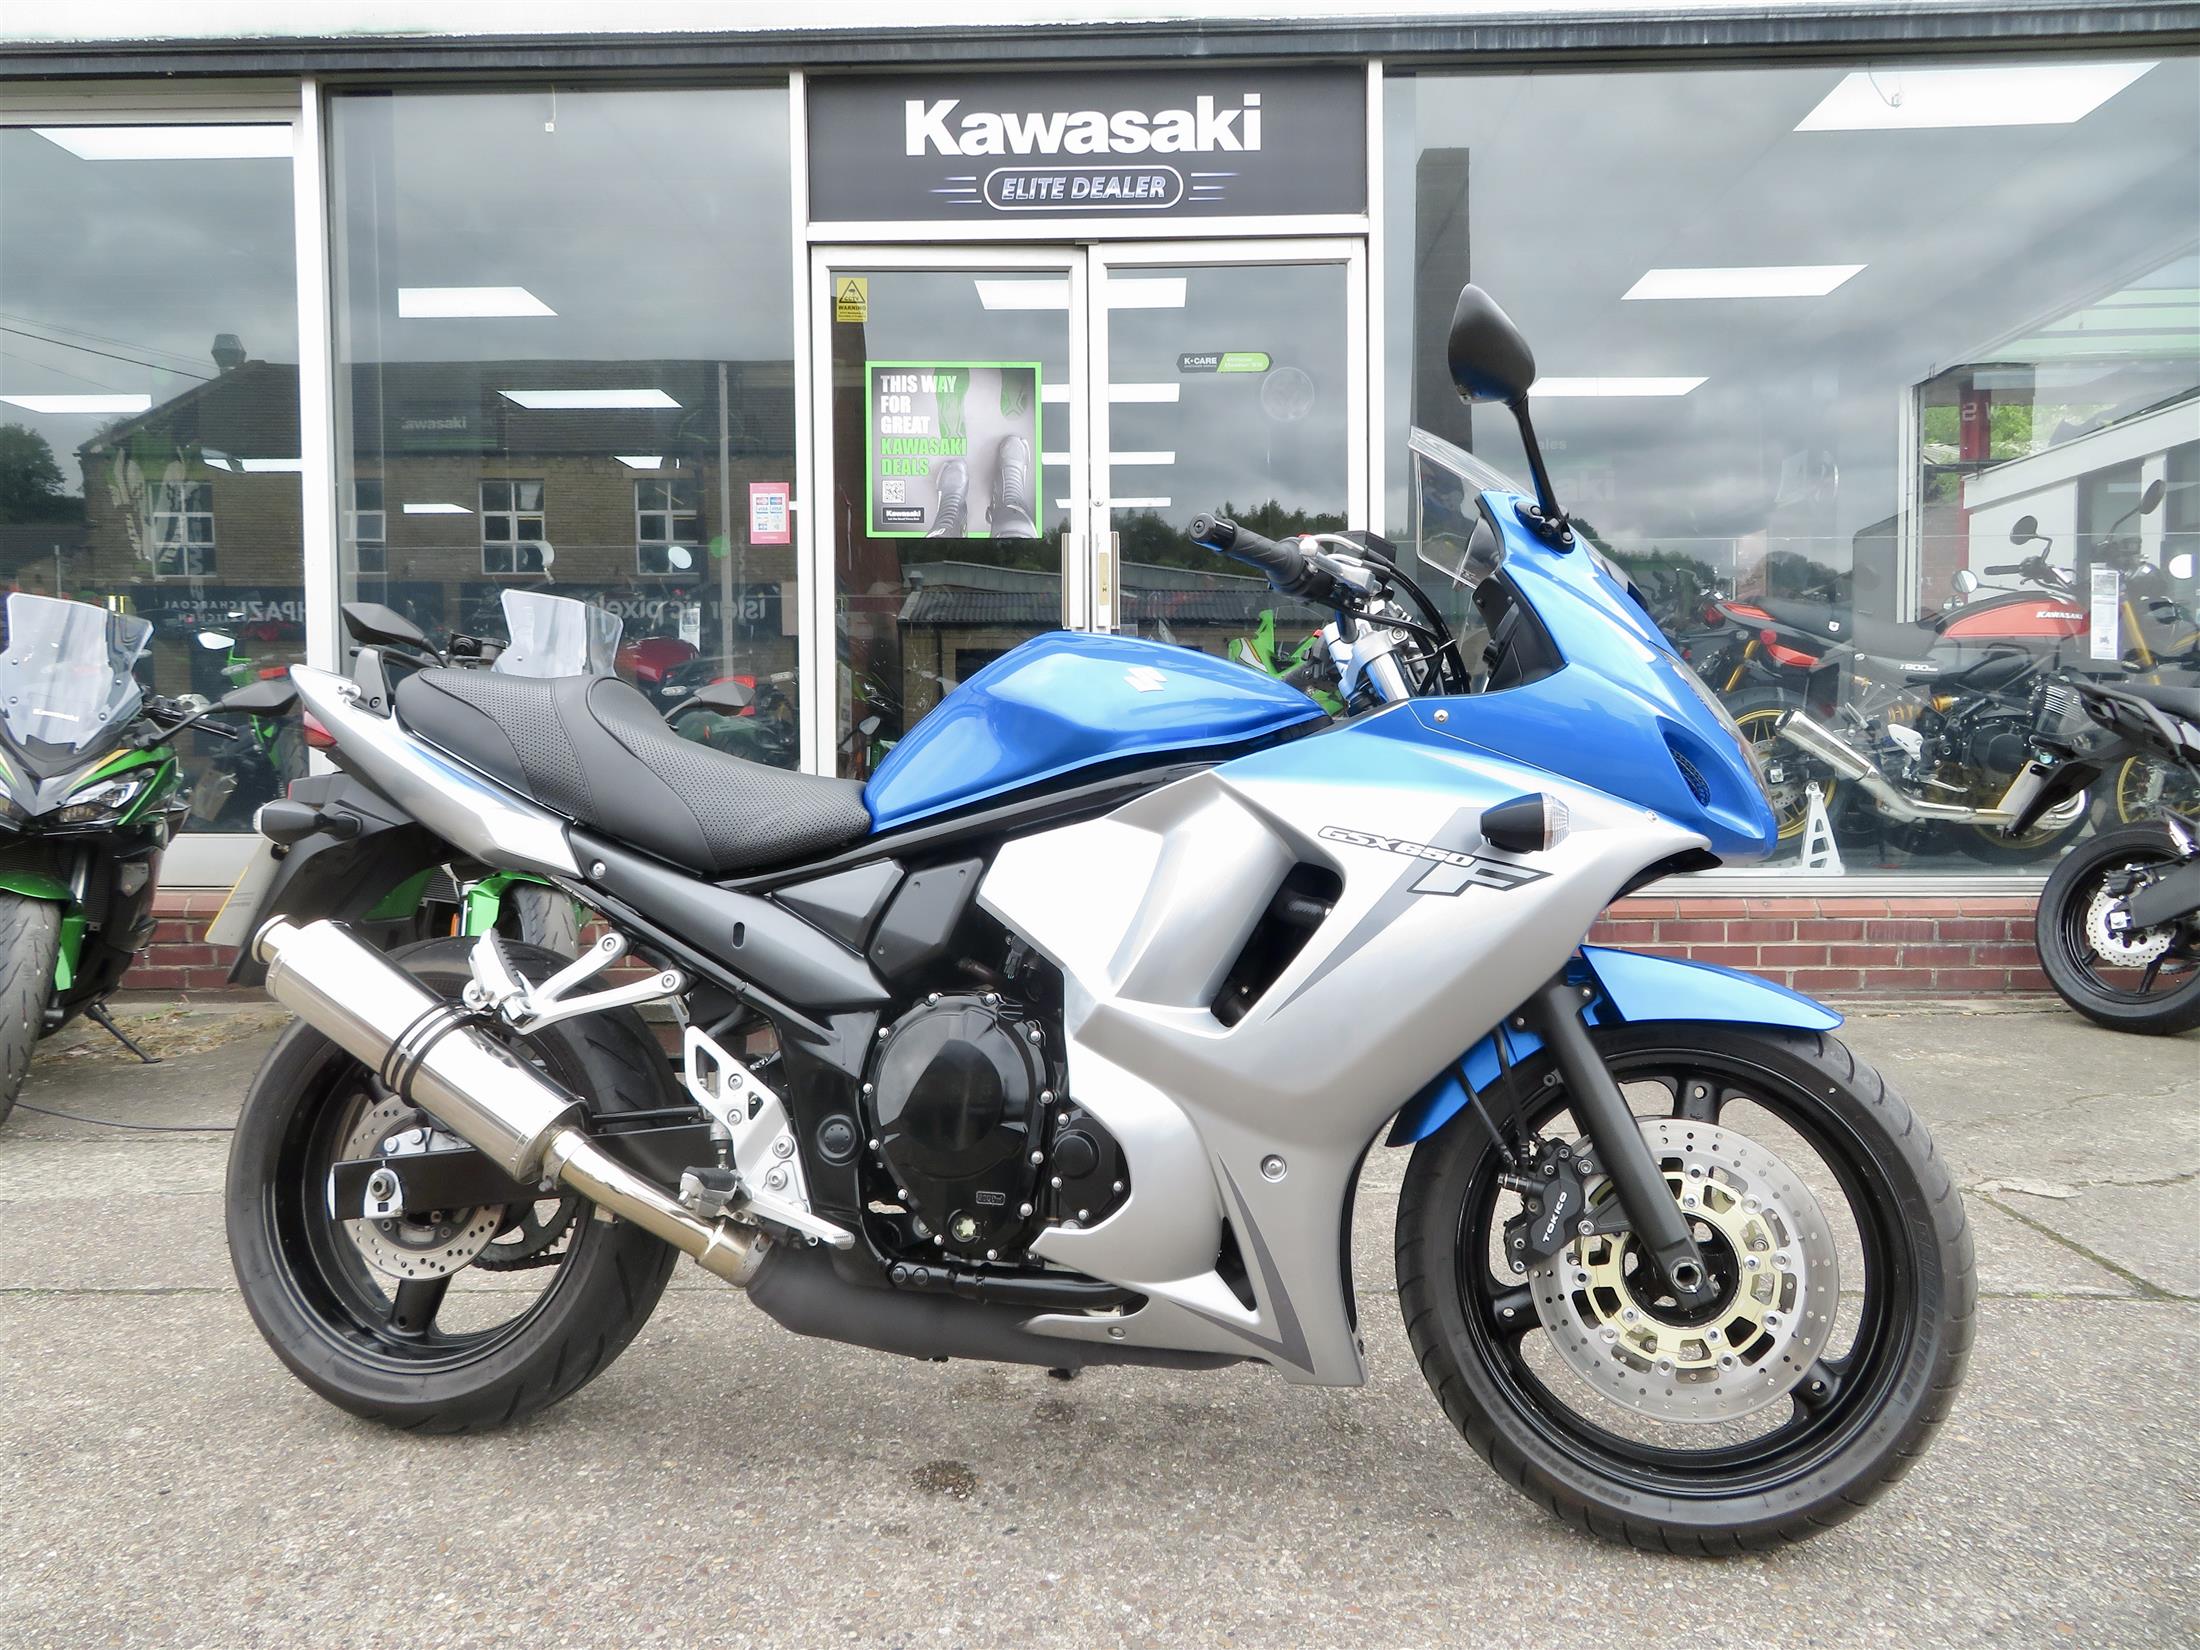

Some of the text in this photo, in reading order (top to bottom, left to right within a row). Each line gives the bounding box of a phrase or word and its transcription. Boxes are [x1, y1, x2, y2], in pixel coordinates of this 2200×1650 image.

[905, 93, 1262, 156] Kawasaki
[1001, 175, 1166, 200] ELITE DEALER
[880, 375, 958, 393] THIS WAY
[880, 395, 912, 414] FOR
[880, 416, 931, 434] GREAT
[880, 437, 968, 456] KAWASAKI
[1538, 439, 1568, 450] ales
[880, 458, 931, 477] DEALS
[2036, 611, 2083, 620] KAWASAKI
[1542, 1191, 1568, 1243] TOKICO
